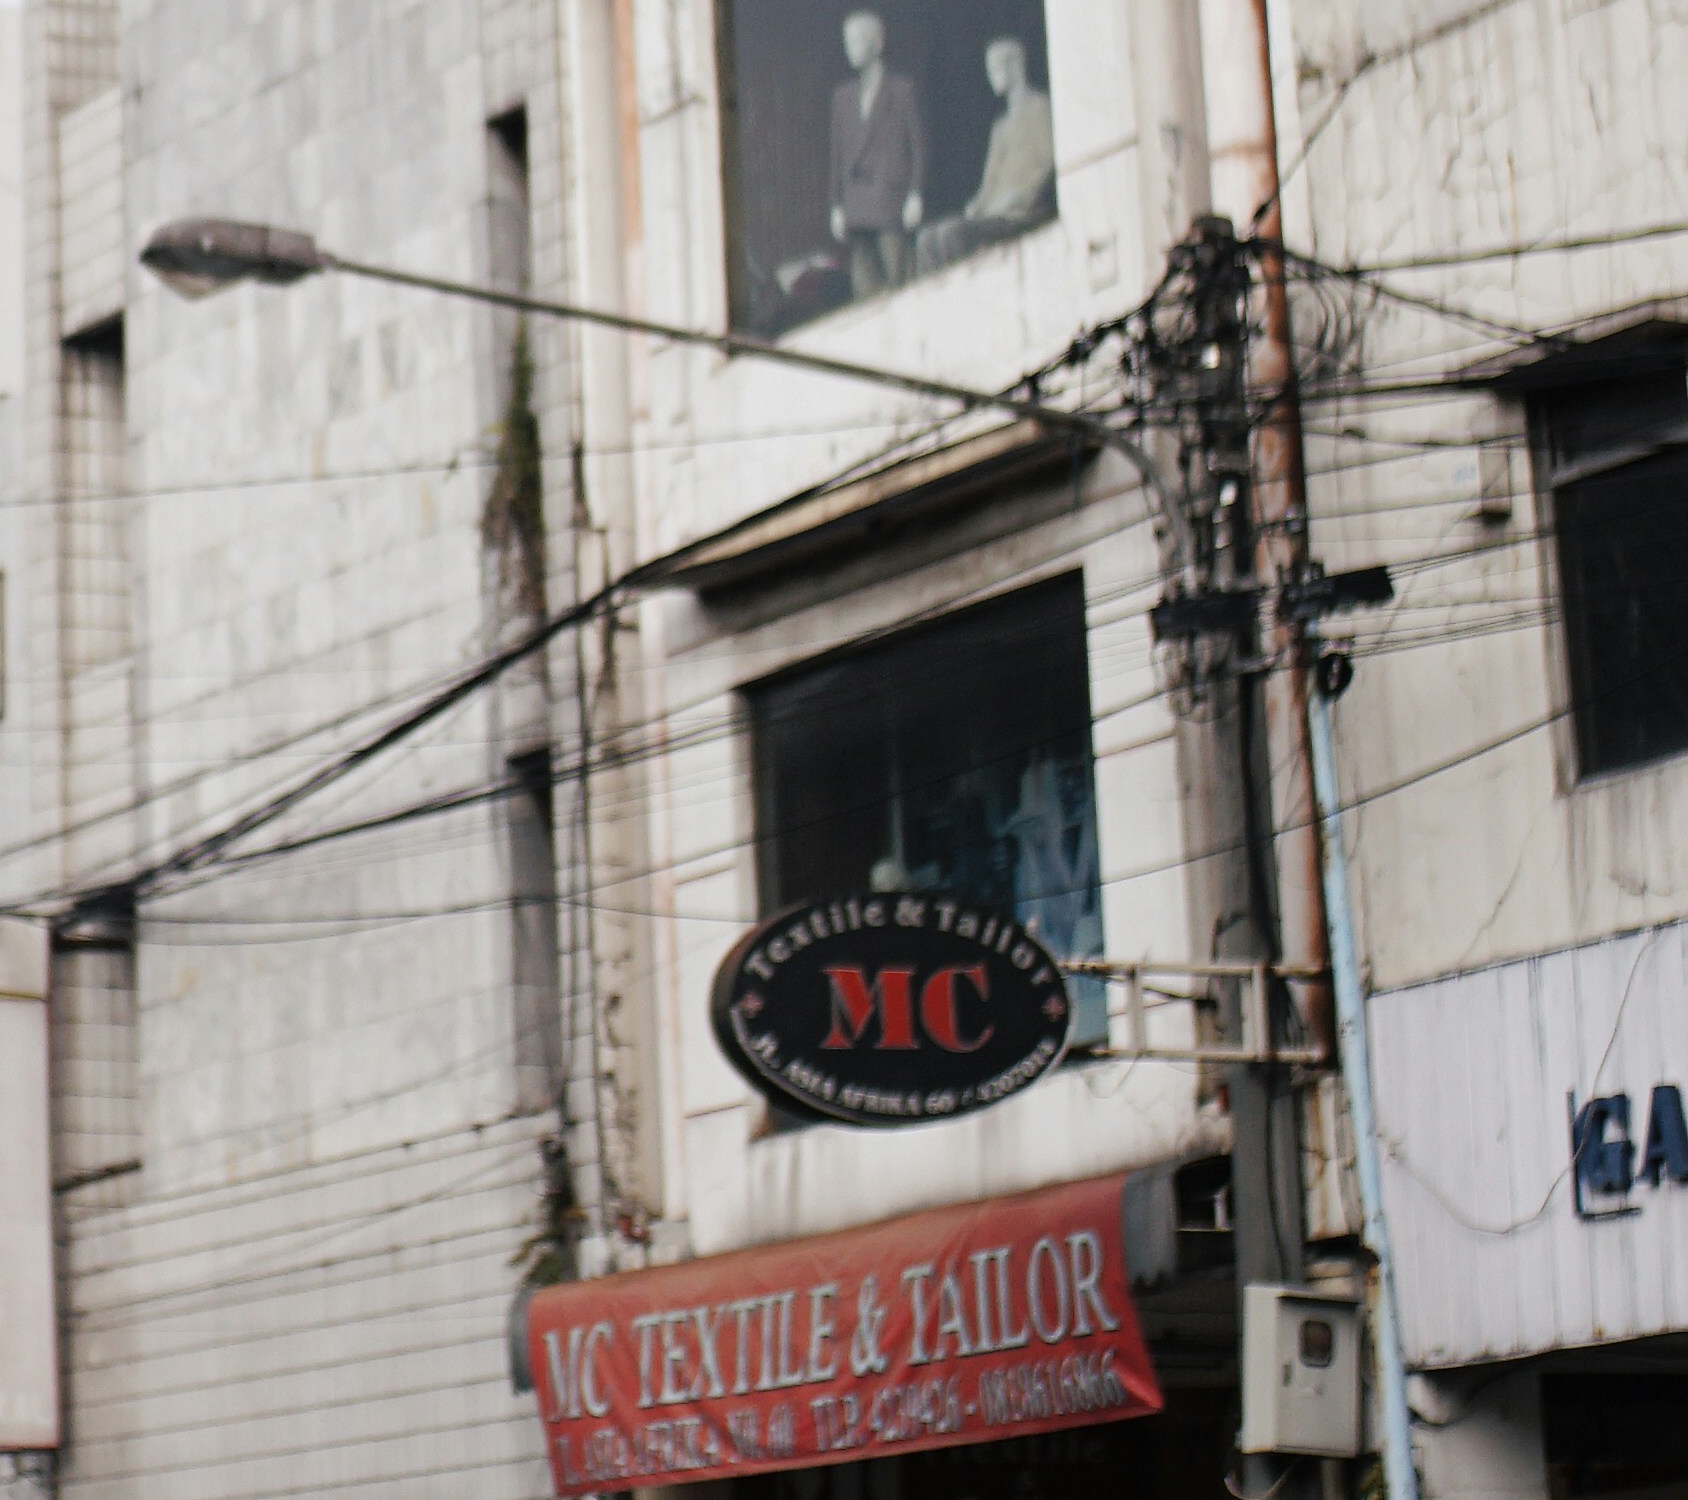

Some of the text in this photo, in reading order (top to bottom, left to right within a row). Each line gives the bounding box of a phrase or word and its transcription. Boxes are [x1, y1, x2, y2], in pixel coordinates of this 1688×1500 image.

[744, 895, 1054, 985] Textile & Tailor
[820, 962, 994, 1053] MC
[544, 1231, 1119, 1424] MC TEXTILE & TAILOR
